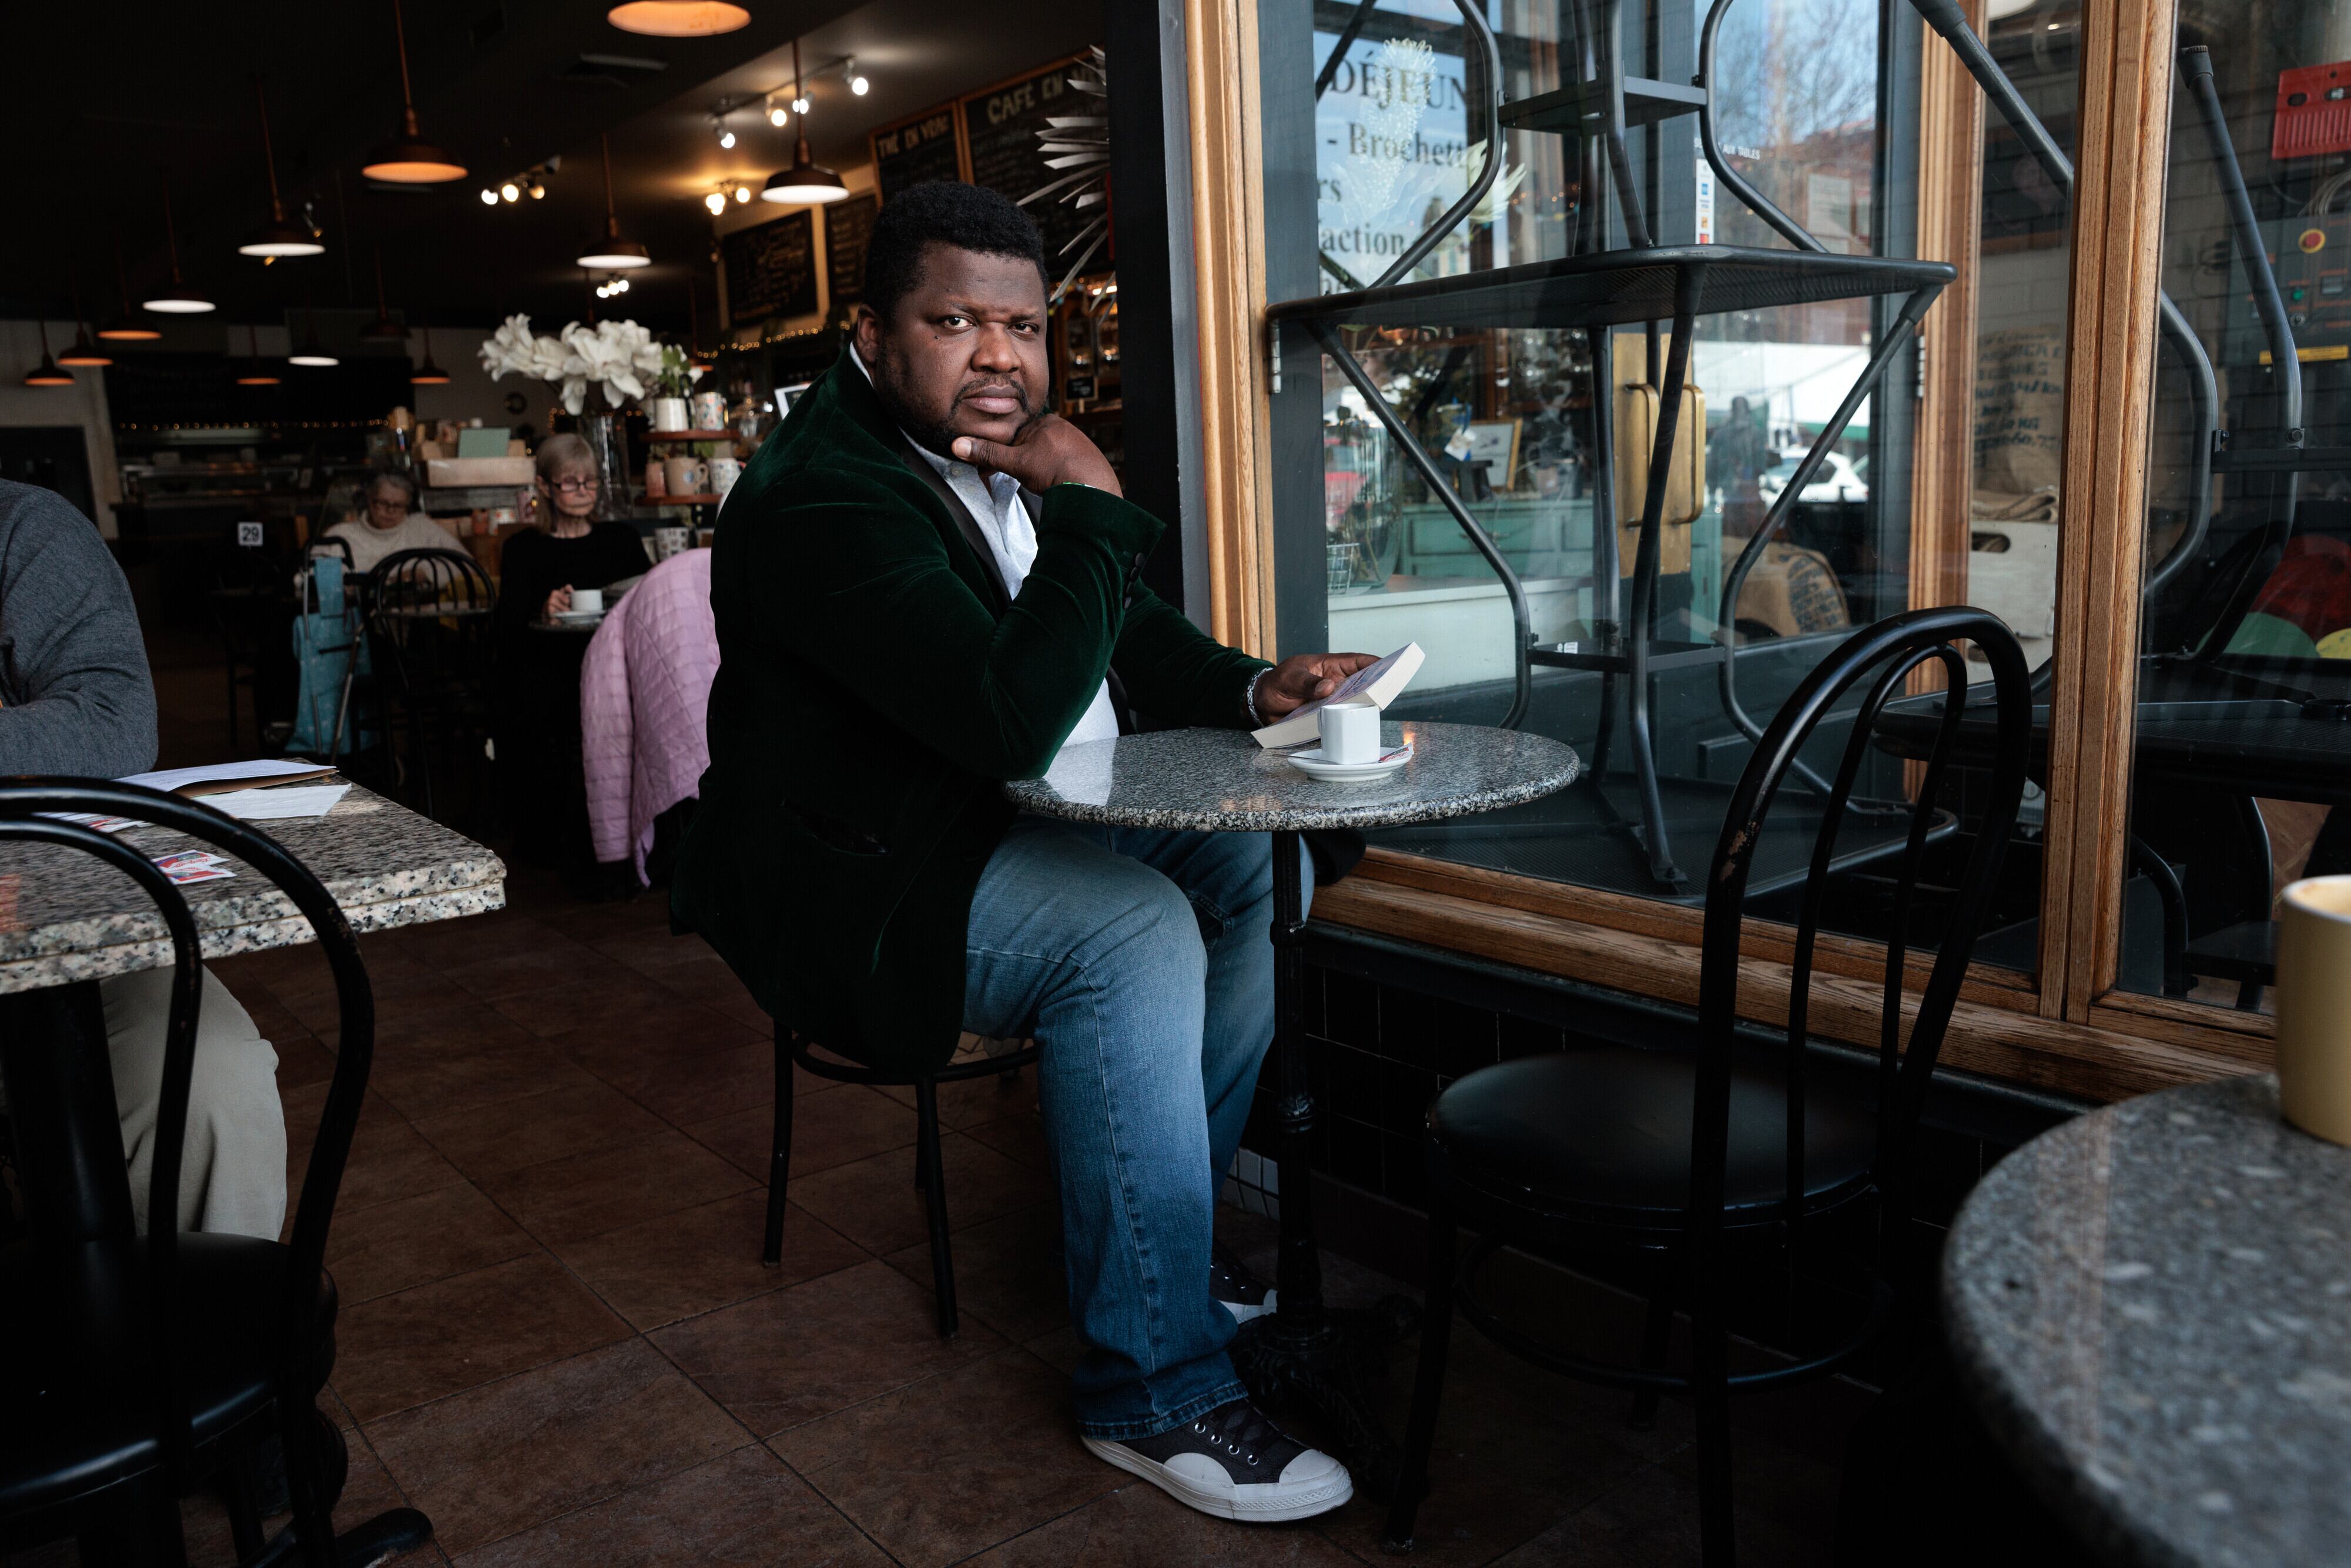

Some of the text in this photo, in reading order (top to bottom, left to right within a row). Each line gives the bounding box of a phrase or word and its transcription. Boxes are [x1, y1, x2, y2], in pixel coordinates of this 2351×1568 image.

[987, 82, 1036, 124] CAFÉ
[1041, 71, 1064, 100] EN
[242, 525, 260, 541] 29
